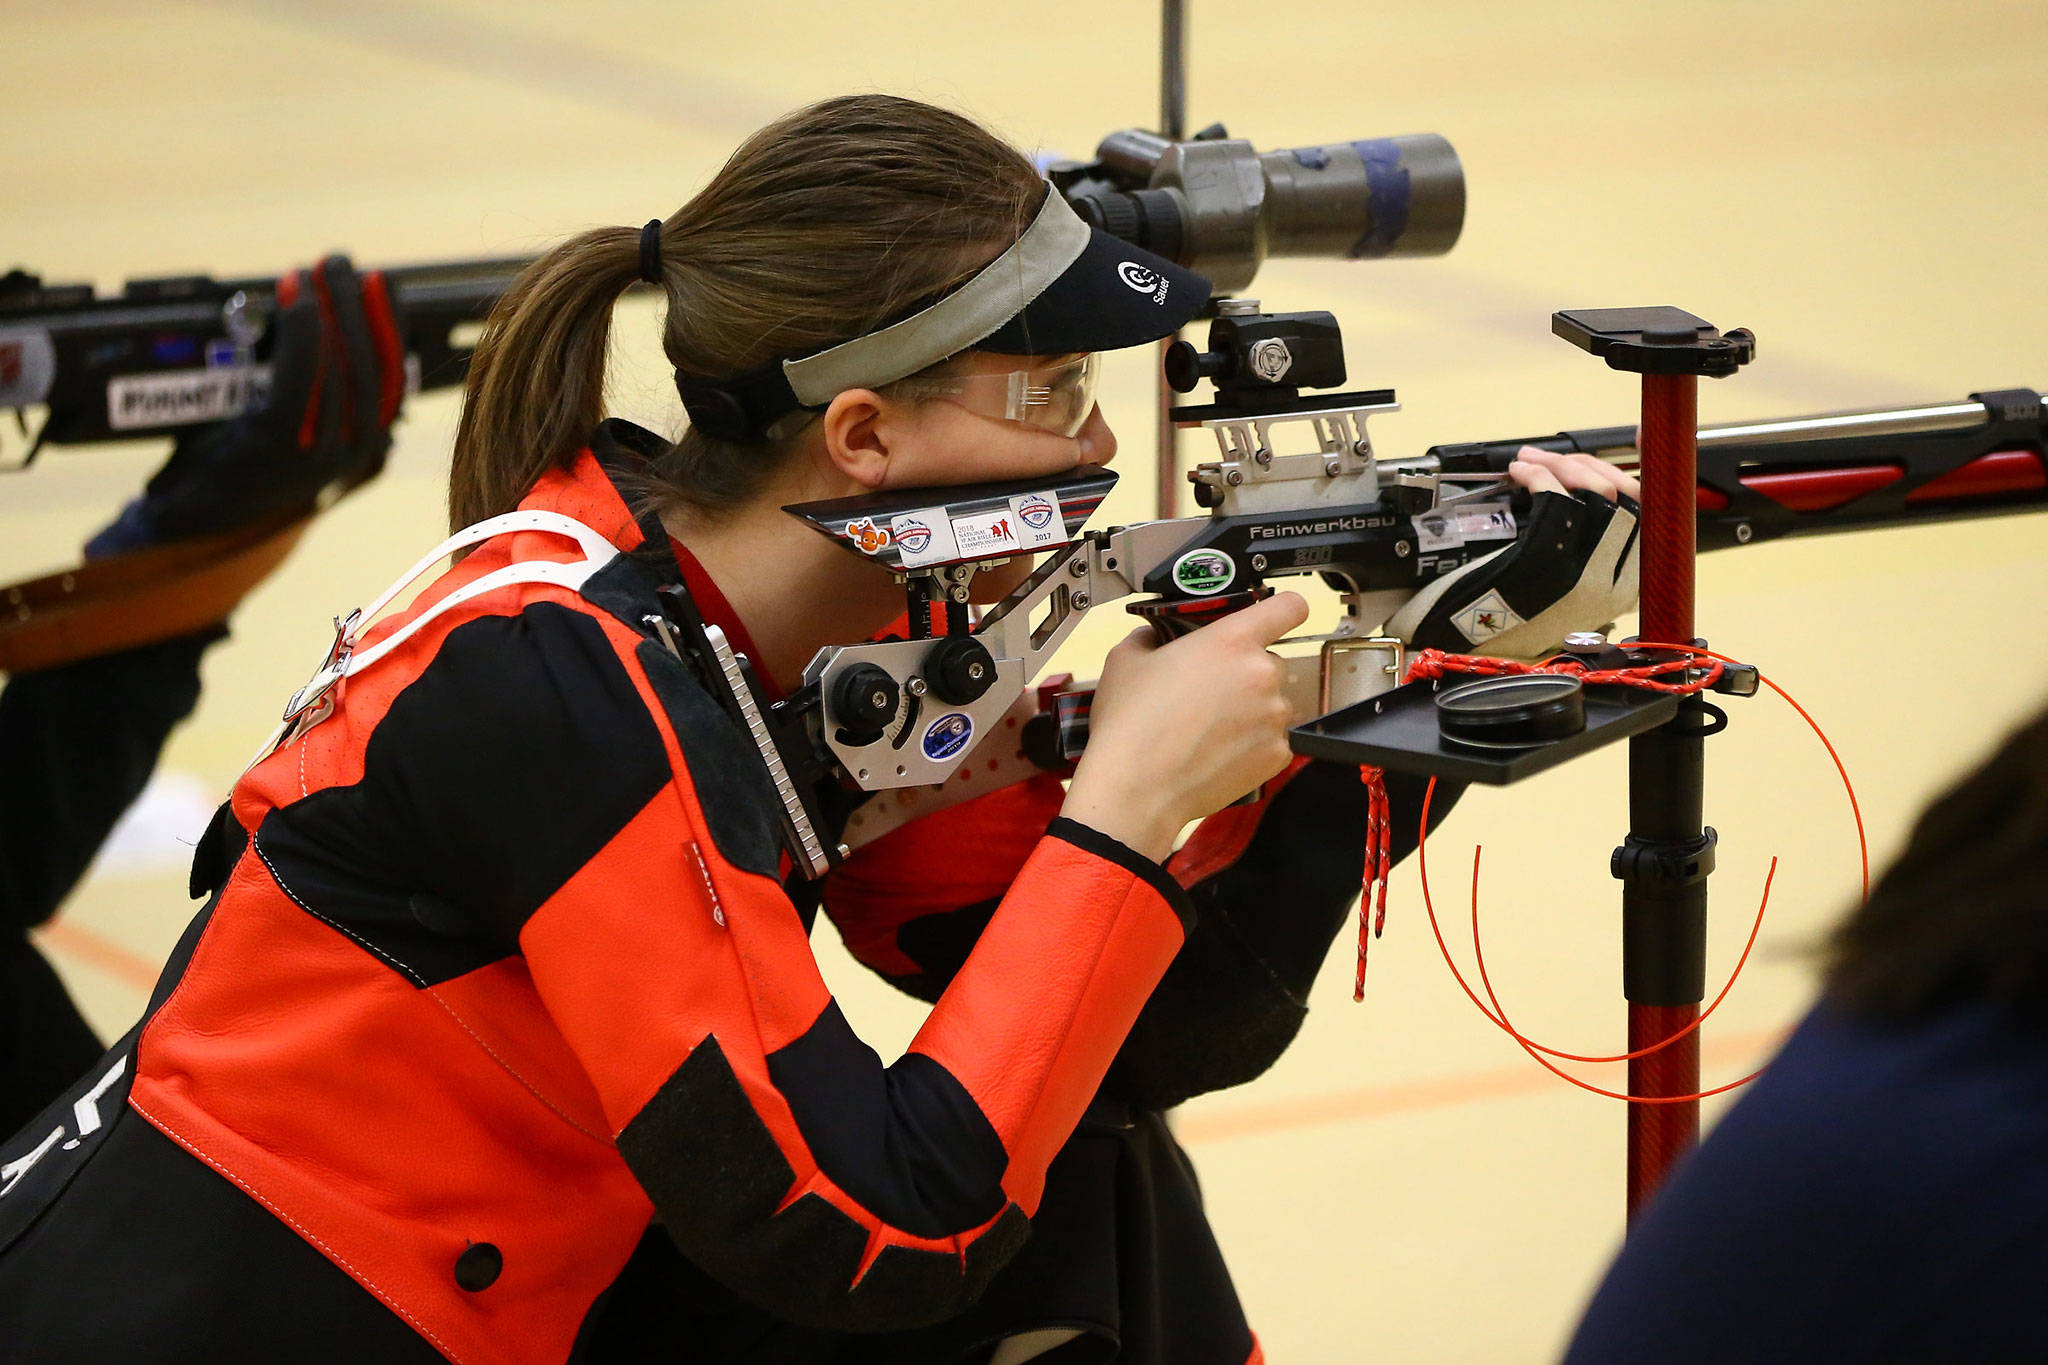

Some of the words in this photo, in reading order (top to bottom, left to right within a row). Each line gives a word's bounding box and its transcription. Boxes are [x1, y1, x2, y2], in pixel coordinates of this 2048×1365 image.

[1152, 276, 1170, 306] Sauer
[957, 524, 975, 534] 2018
[1250, 516, 1397, 540] Feinwerkbau
[1035, 532, 1052, 542] 2017
